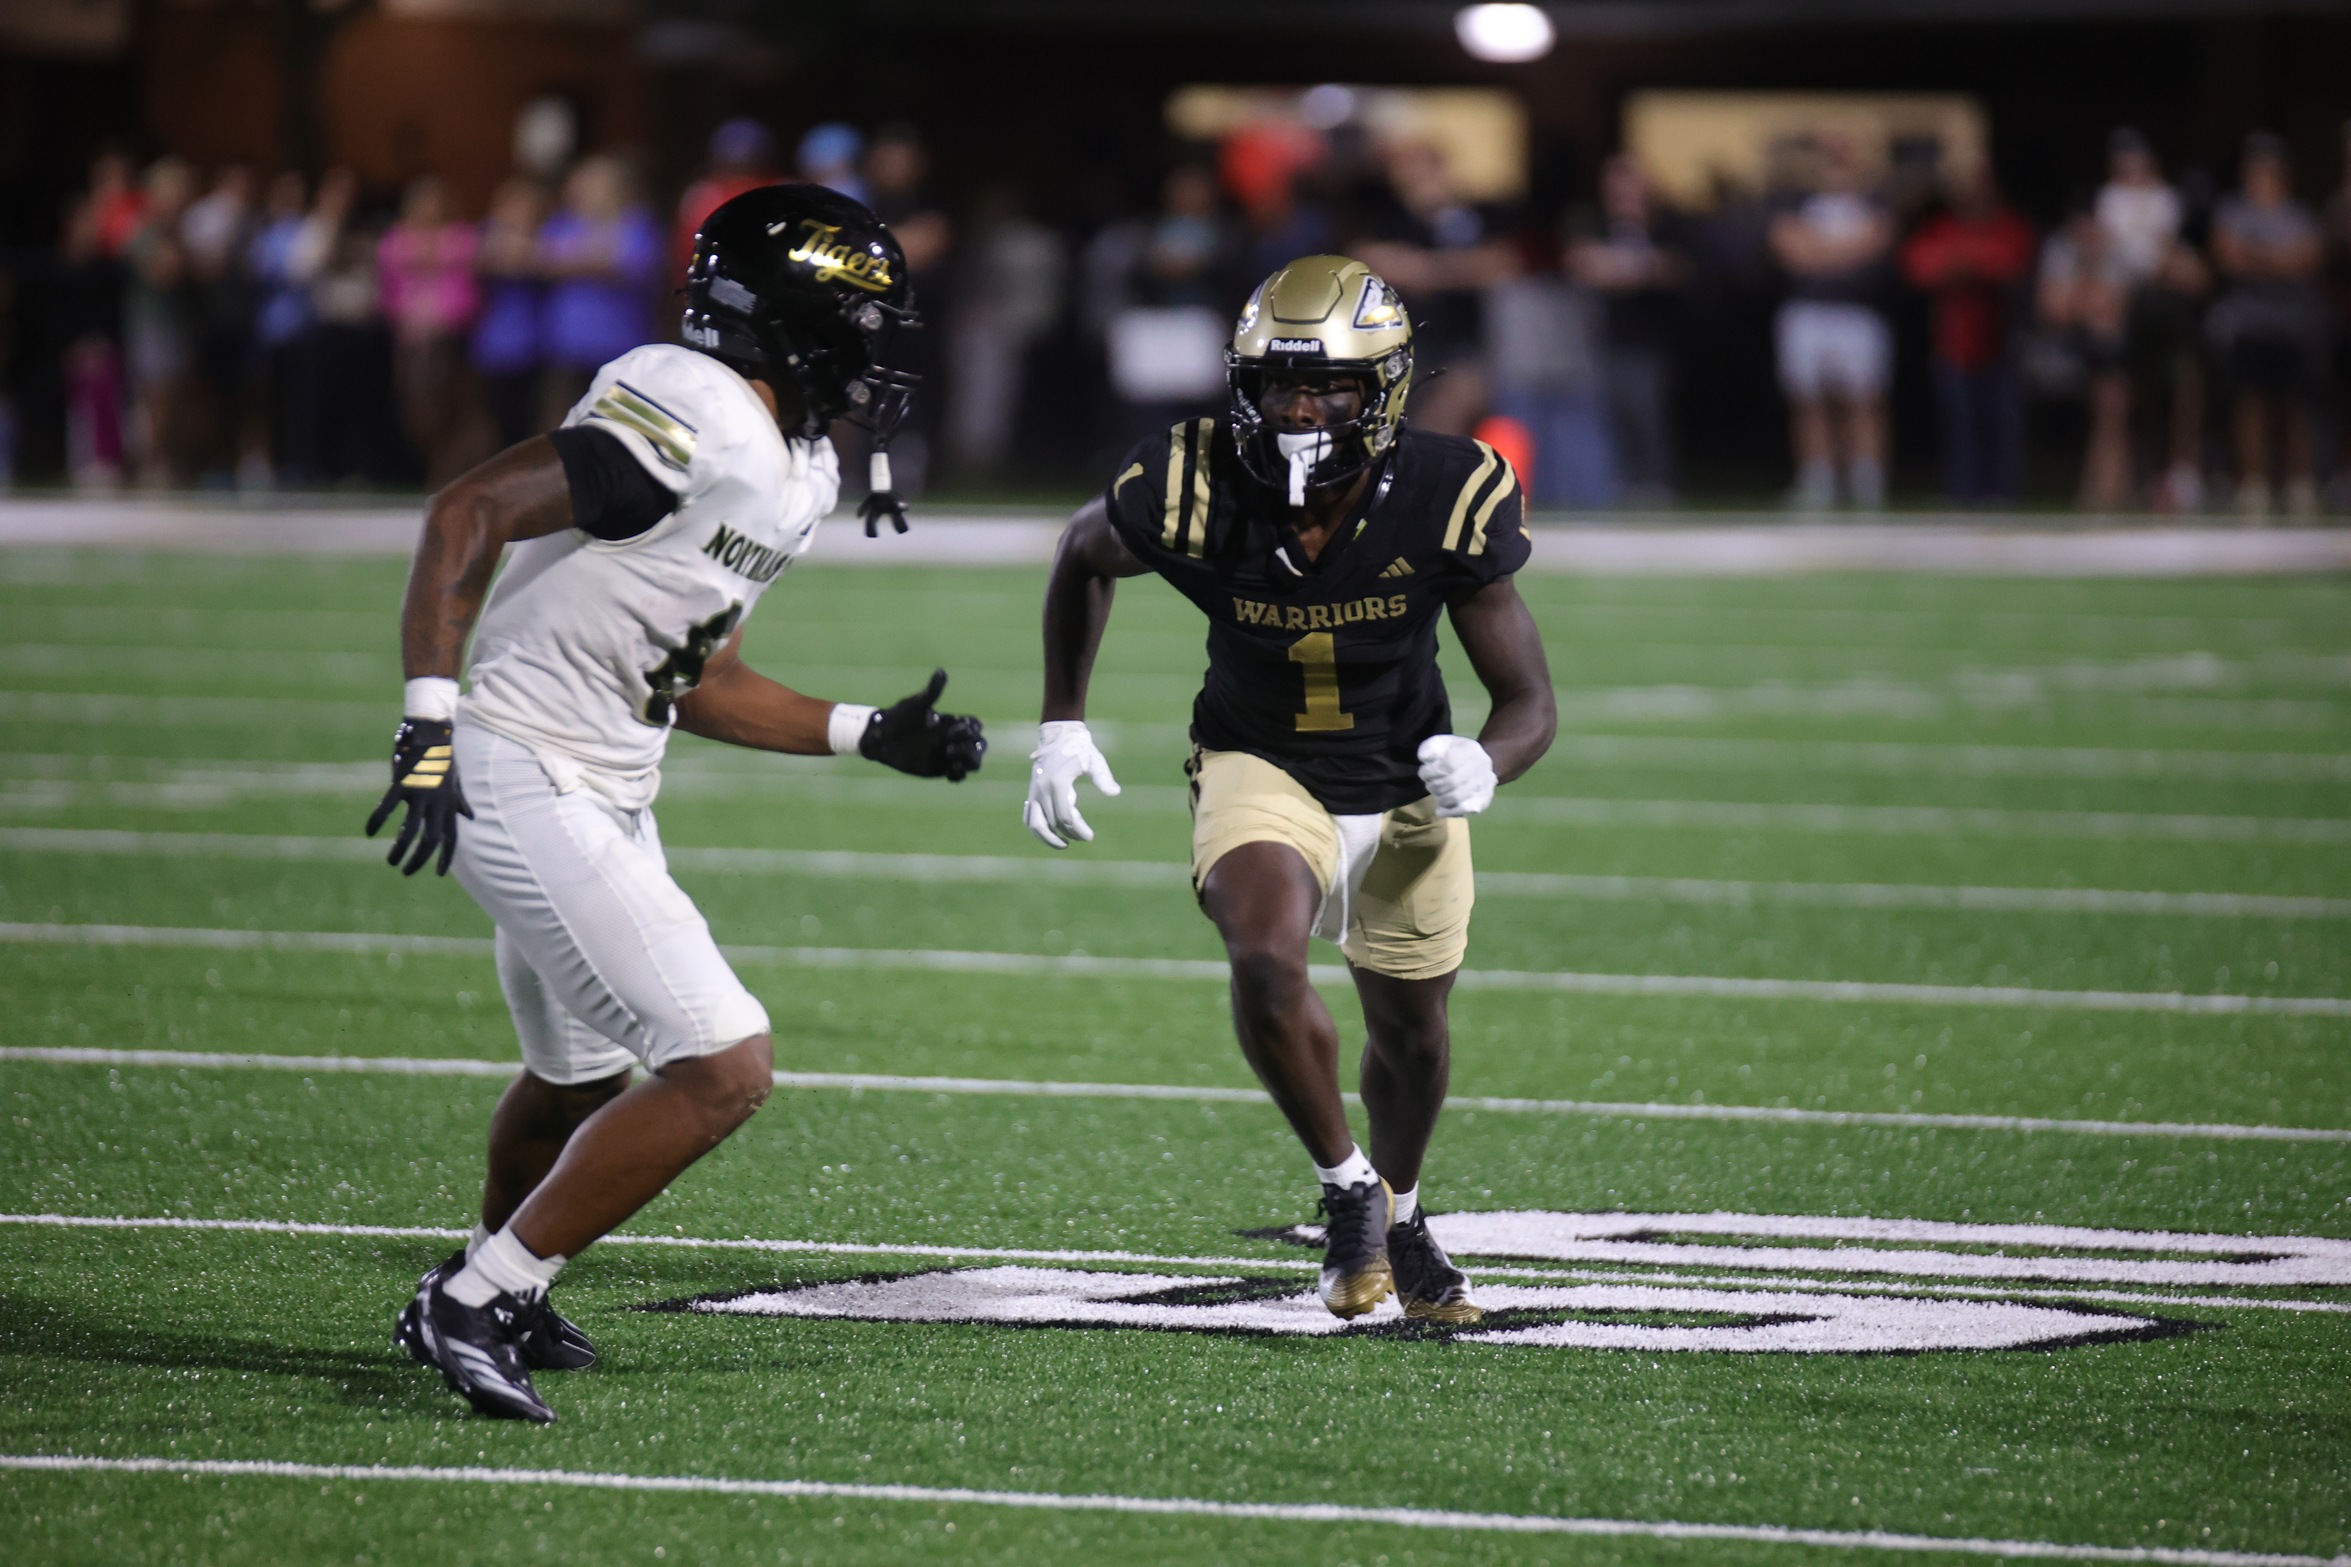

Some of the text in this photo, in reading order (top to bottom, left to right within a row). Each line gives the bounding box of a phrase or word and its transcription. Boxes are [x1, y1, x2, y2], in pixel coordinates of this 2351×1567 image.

[788, 218, 893, 291] Tigers
[1270, 339, 1321, 353] Riddell
[1232, 594, 1407, 630] WARRIORS
[1288, 631, 1355, 731] 1
